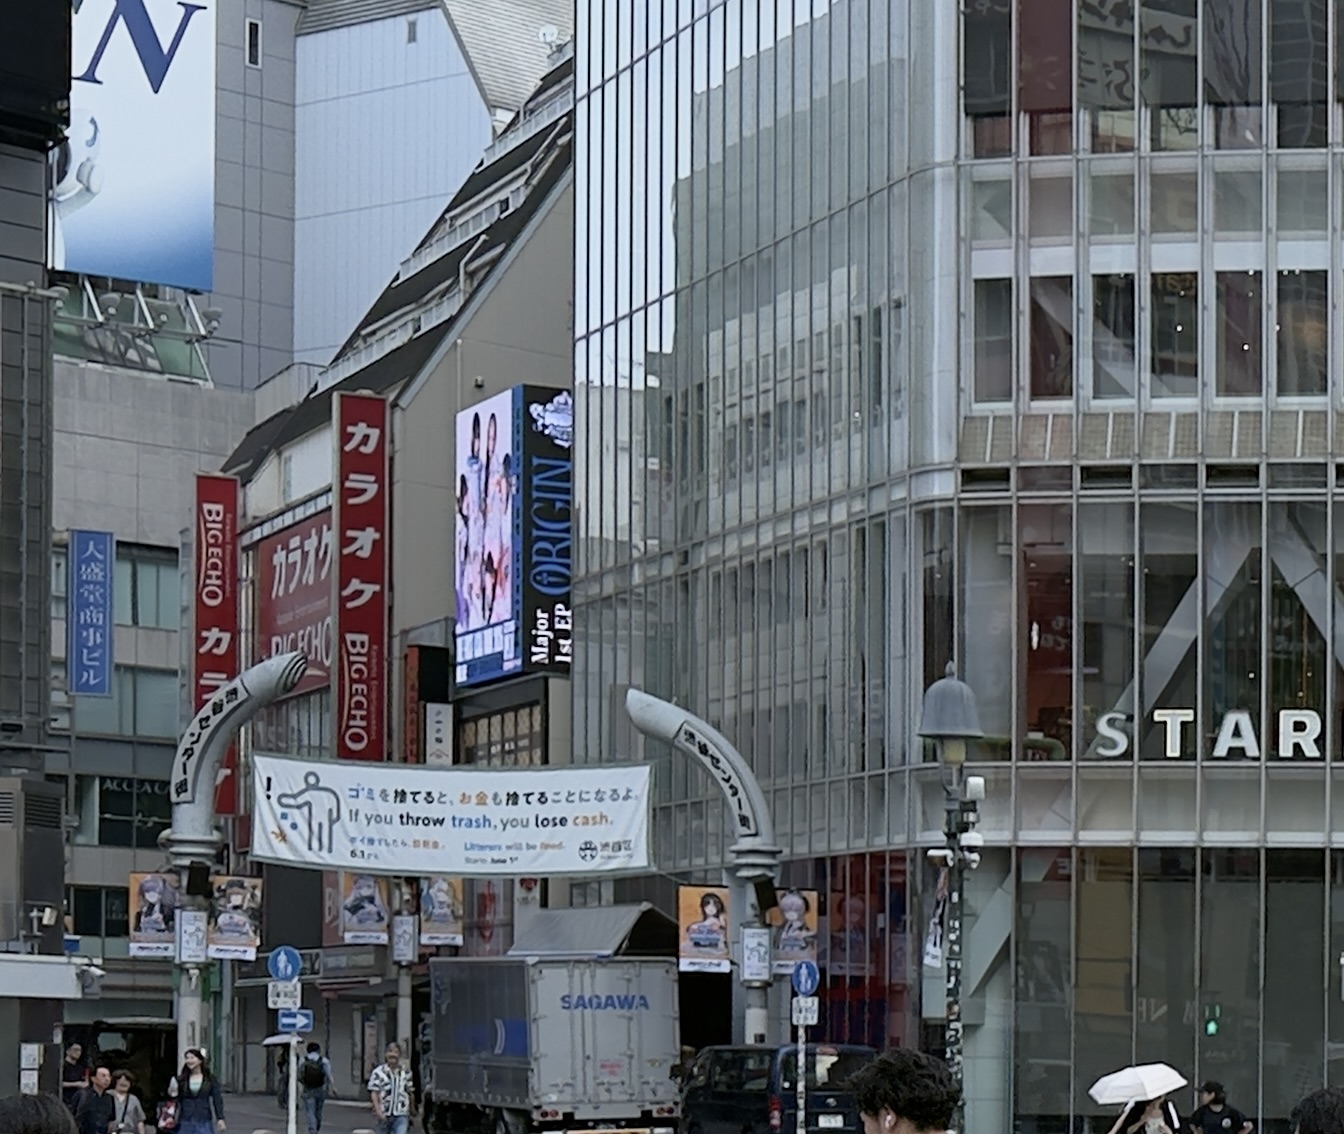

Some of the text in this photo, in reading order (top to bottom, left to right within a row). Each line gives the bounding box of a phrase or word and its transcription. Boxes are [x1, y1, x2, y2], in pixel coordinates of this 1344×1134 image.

[70, 0, 208, 94] N
[202, 502, 225, 607] BIG ECHO
[271, 523, 332, 600] カラオケ
[341, 421, 381, 609] カラオケ
[529, 456, 572, 595] ORIGIN
[79, 540, 105, 685] 大盛堂商事ビル
[531, 608, 553, 665] Major
[344, 633, 369, 751] BIG ECHO
[350, 810, 359, 823] If
[364, 813, 393, 831] you
[400, 810, 446, 827] throw
[500, 816, 529, 831] you
[535, 813, 568, 828] lose
[573, 812, 614, 827] cash.
[560, 994, 650, 1011] SAGAWA
